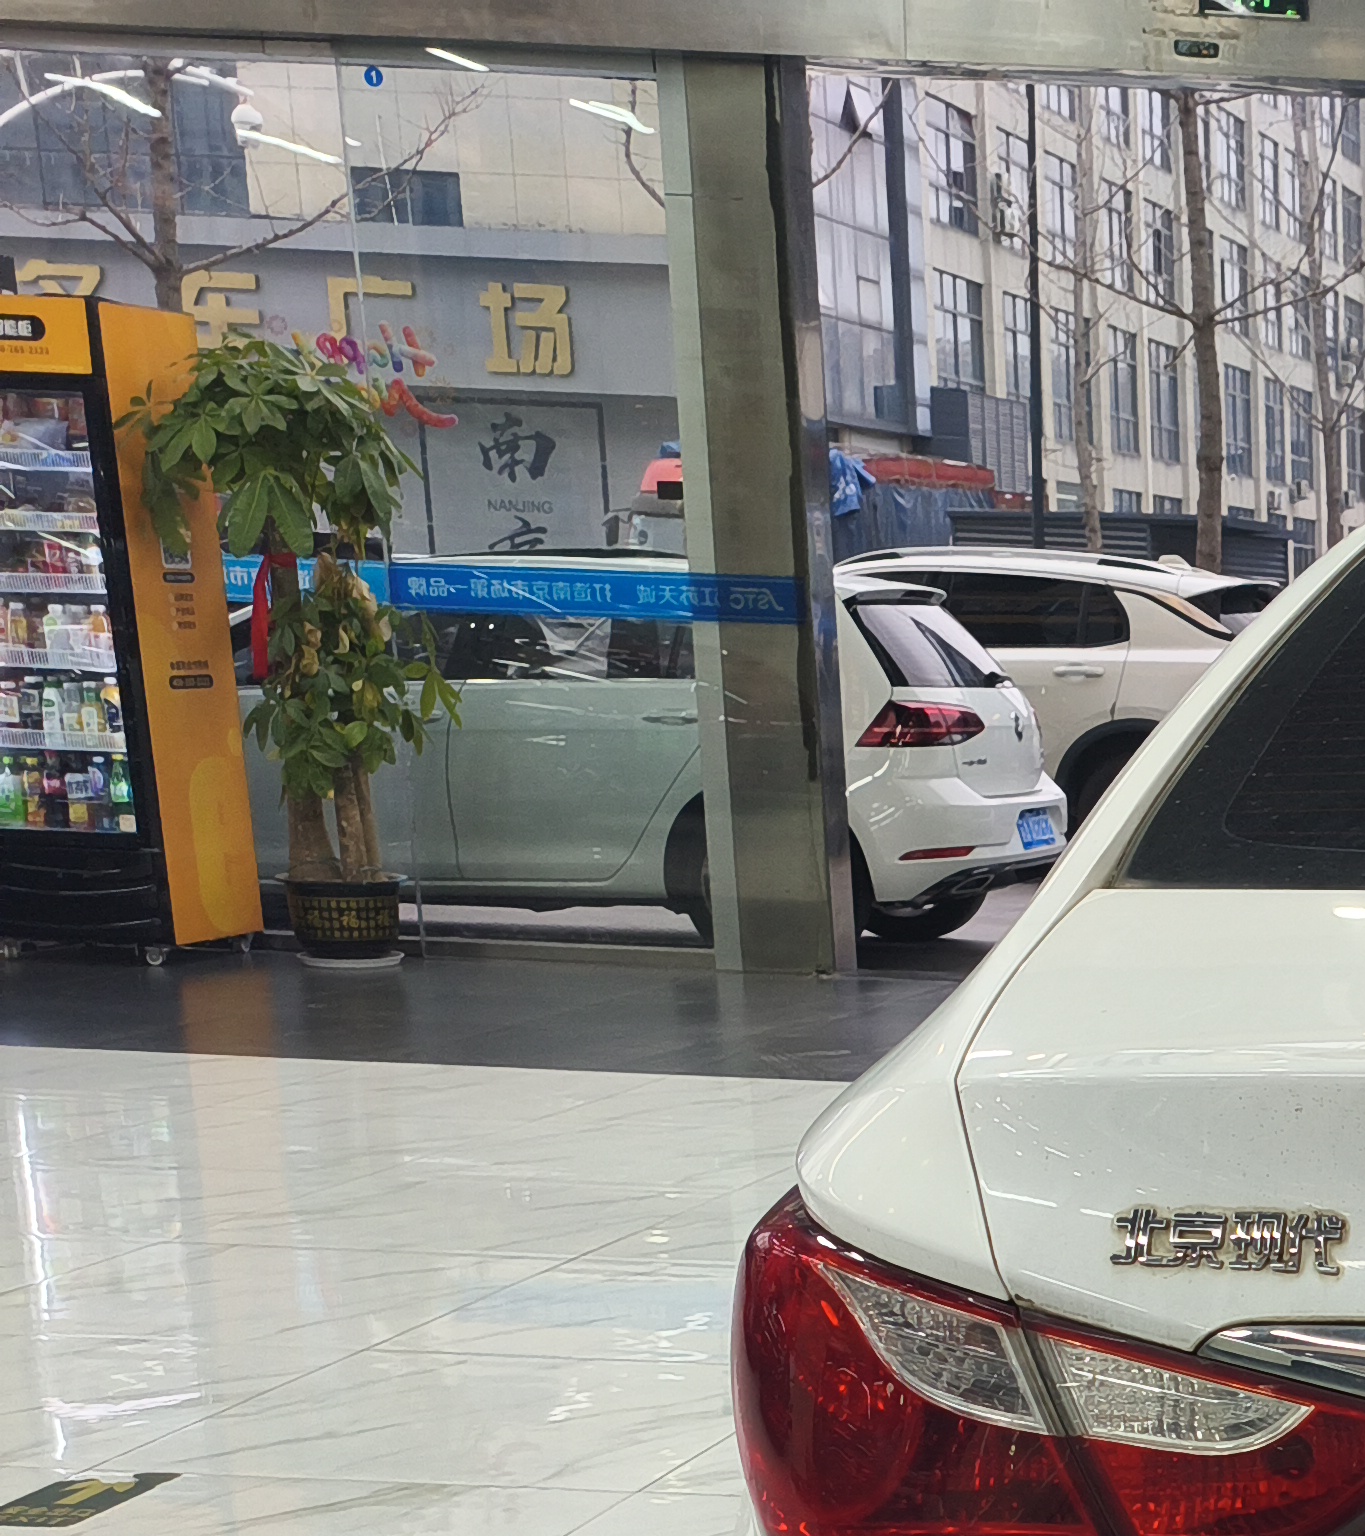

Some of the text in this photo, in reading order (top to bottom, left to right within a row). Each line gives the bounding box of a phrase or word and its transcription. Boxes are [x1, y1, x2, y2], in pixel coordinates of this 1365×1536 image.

[487, 498, 554, 515] NANJING
[1110, 1208, 1347, 1276] 北京现代
